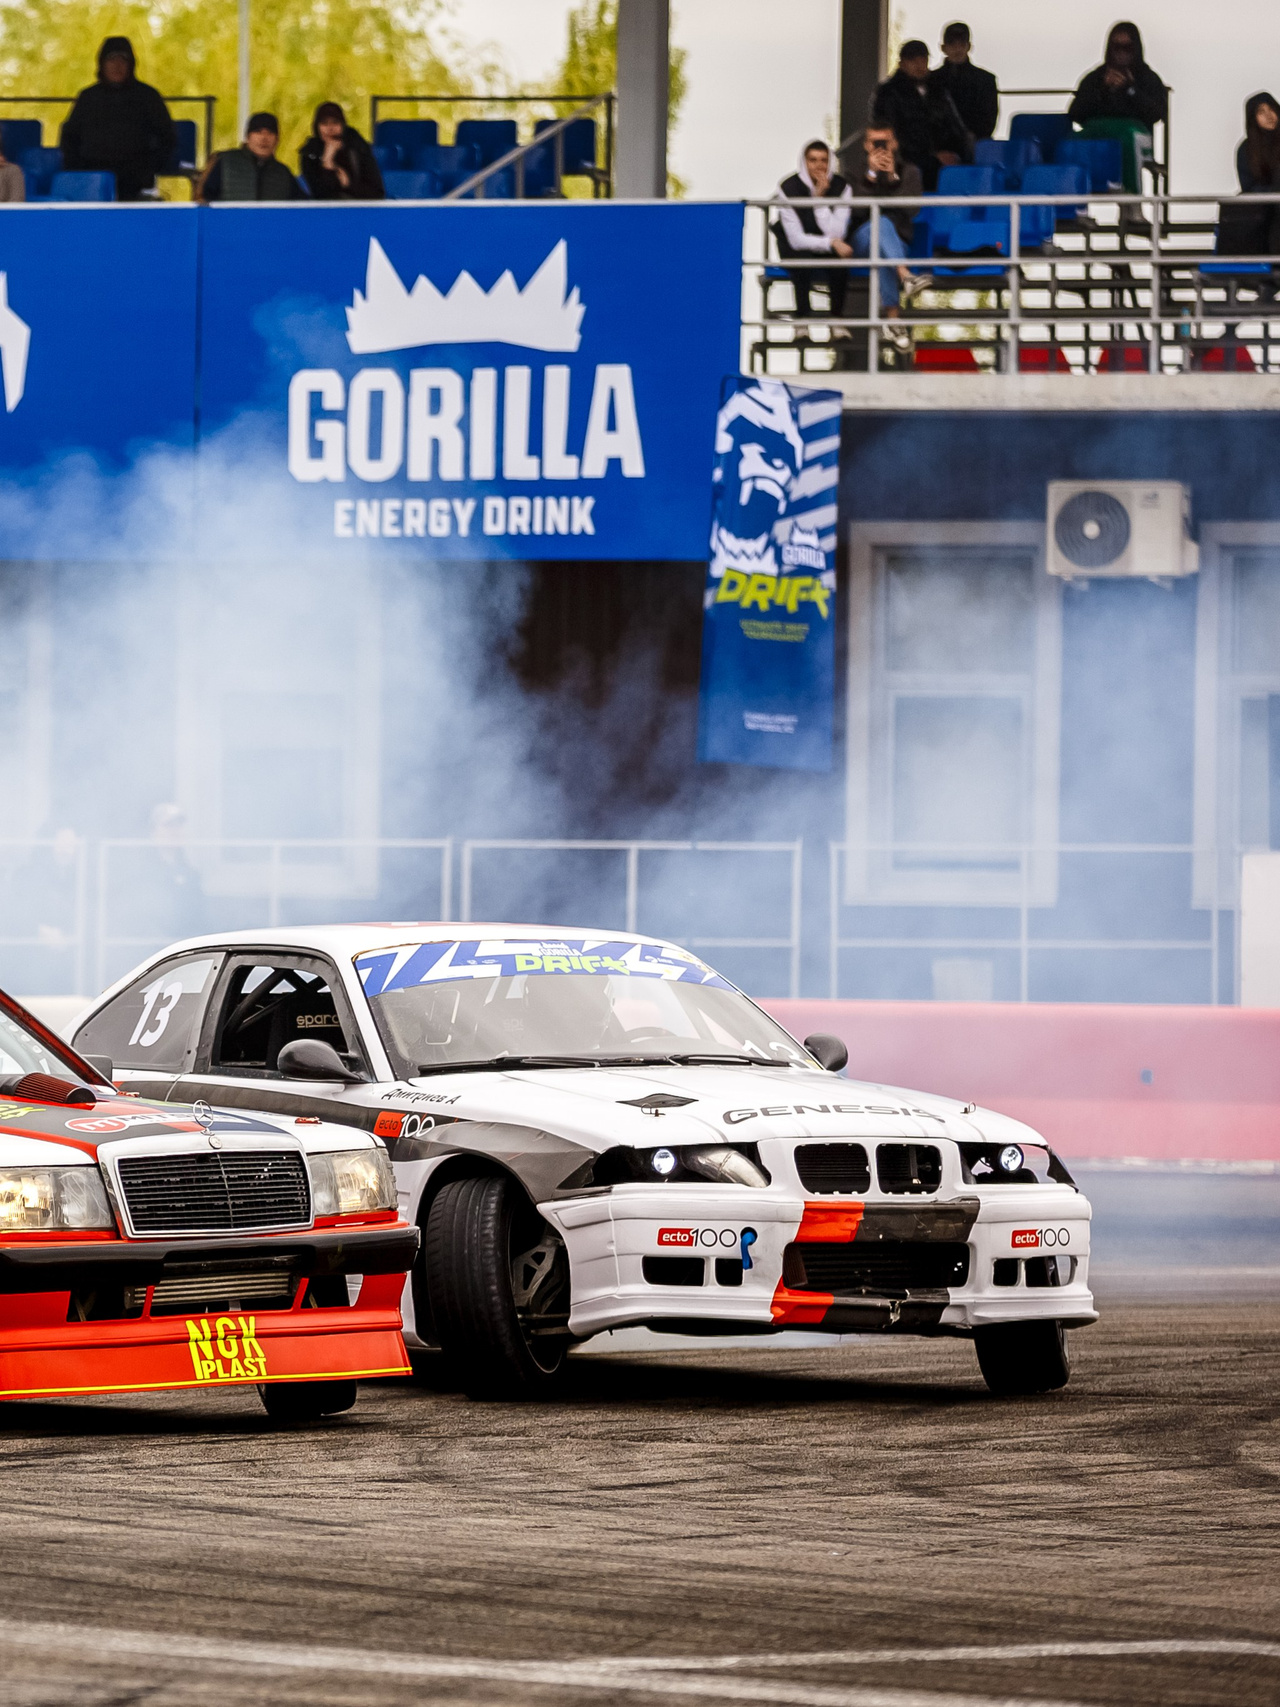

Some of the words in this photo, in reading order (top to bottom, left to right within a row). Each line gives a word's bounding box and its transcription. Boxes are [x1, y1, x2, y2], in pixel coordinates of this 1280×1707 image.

[288, 364, 646, 482] GORILLA
[333, 497, 477, 538] ENERGY
[483, 496, 596, 536] DRINK
[716, 567, 830, 620] DRIFT
[515, 954, 630, 975] DRIFT
[128, 979, 183, 1047] 13
[296, 1014, 340, 1028] sparc
[381, 1088, 447, 1103] Дмитриев
[723, 1104, 946, 1125] GENESIS
[185, 1315, 265, 1379] NGK
[201, 1357, 267, 1379] PLAST
